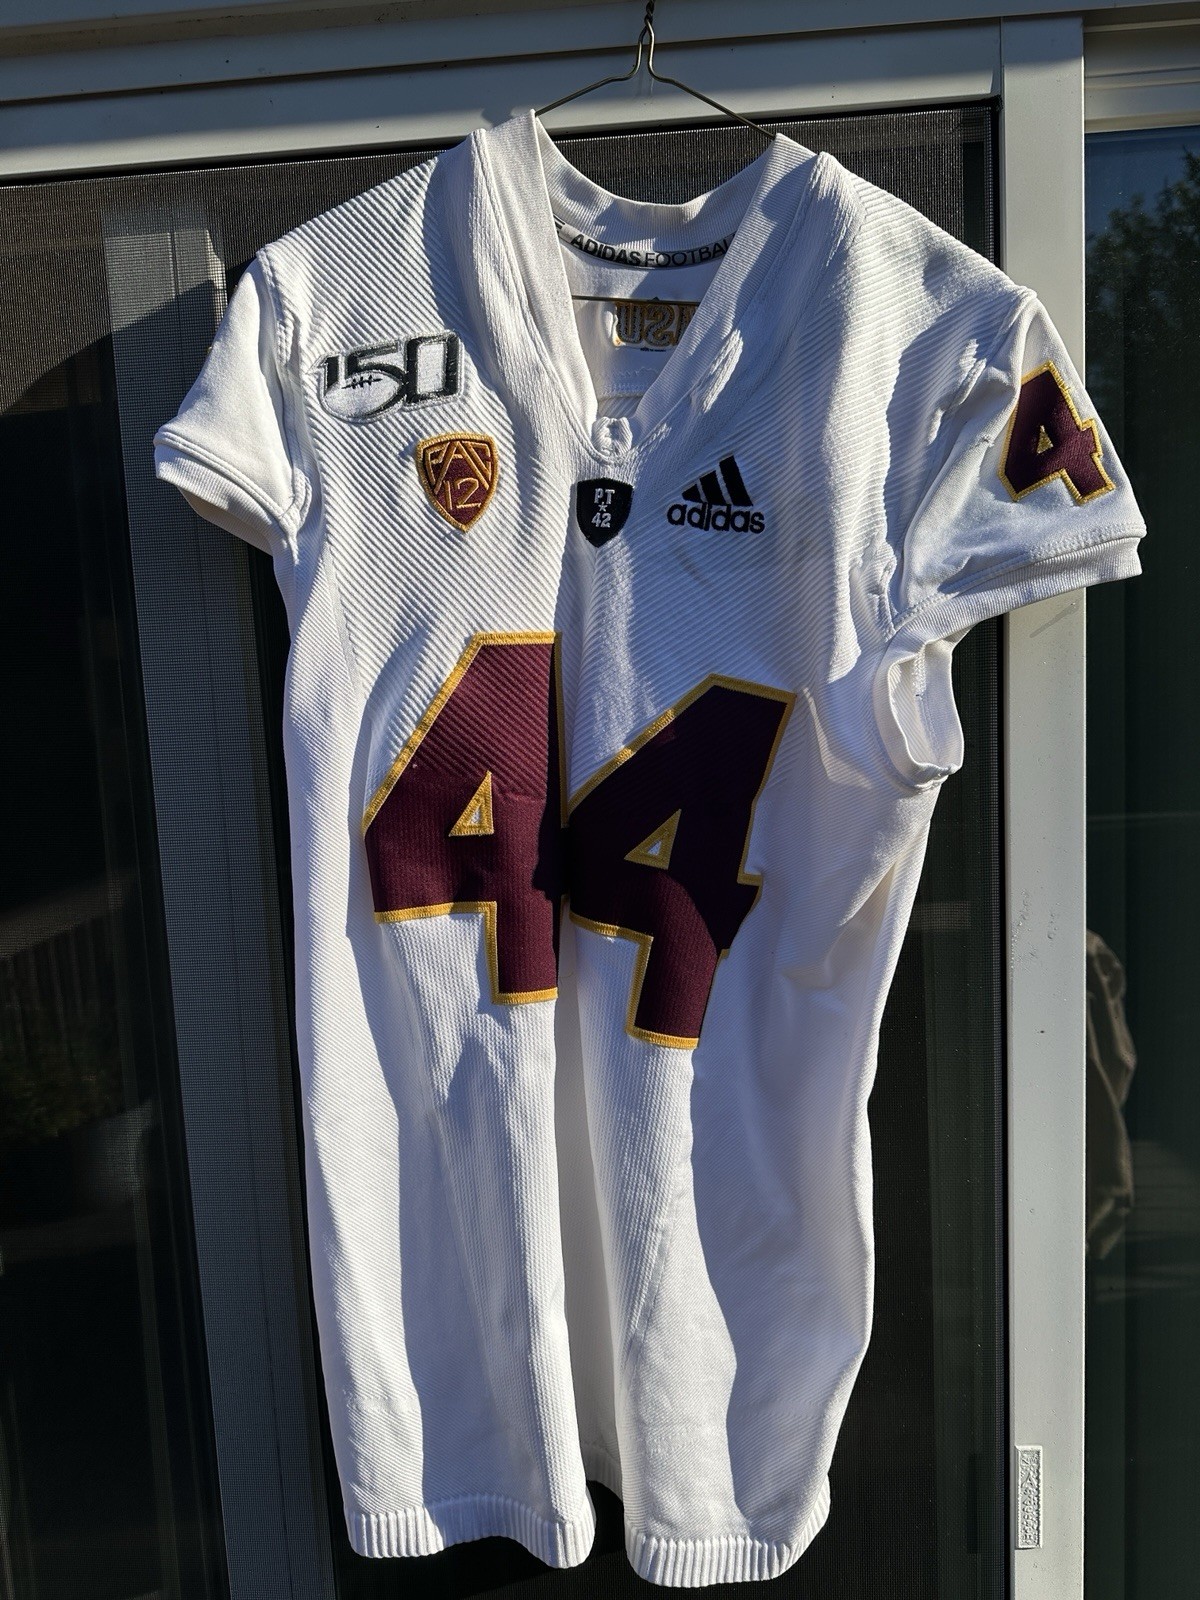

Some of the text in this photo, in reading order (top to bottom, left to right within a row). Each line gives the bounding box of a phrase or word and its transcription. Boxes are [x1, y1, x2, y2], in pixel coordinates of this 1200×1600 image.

[570, 232, 736, 267] ADIDAS FOOTBAL
[319, 332, 462, 420] 150
[998, 360, 1116, 505] 4
[443, 477, 482, 511] 12
[593, 487, 616, 505] PT
[591, 511, 613, 529] 42
[666, 502, 766, 535] adidas
